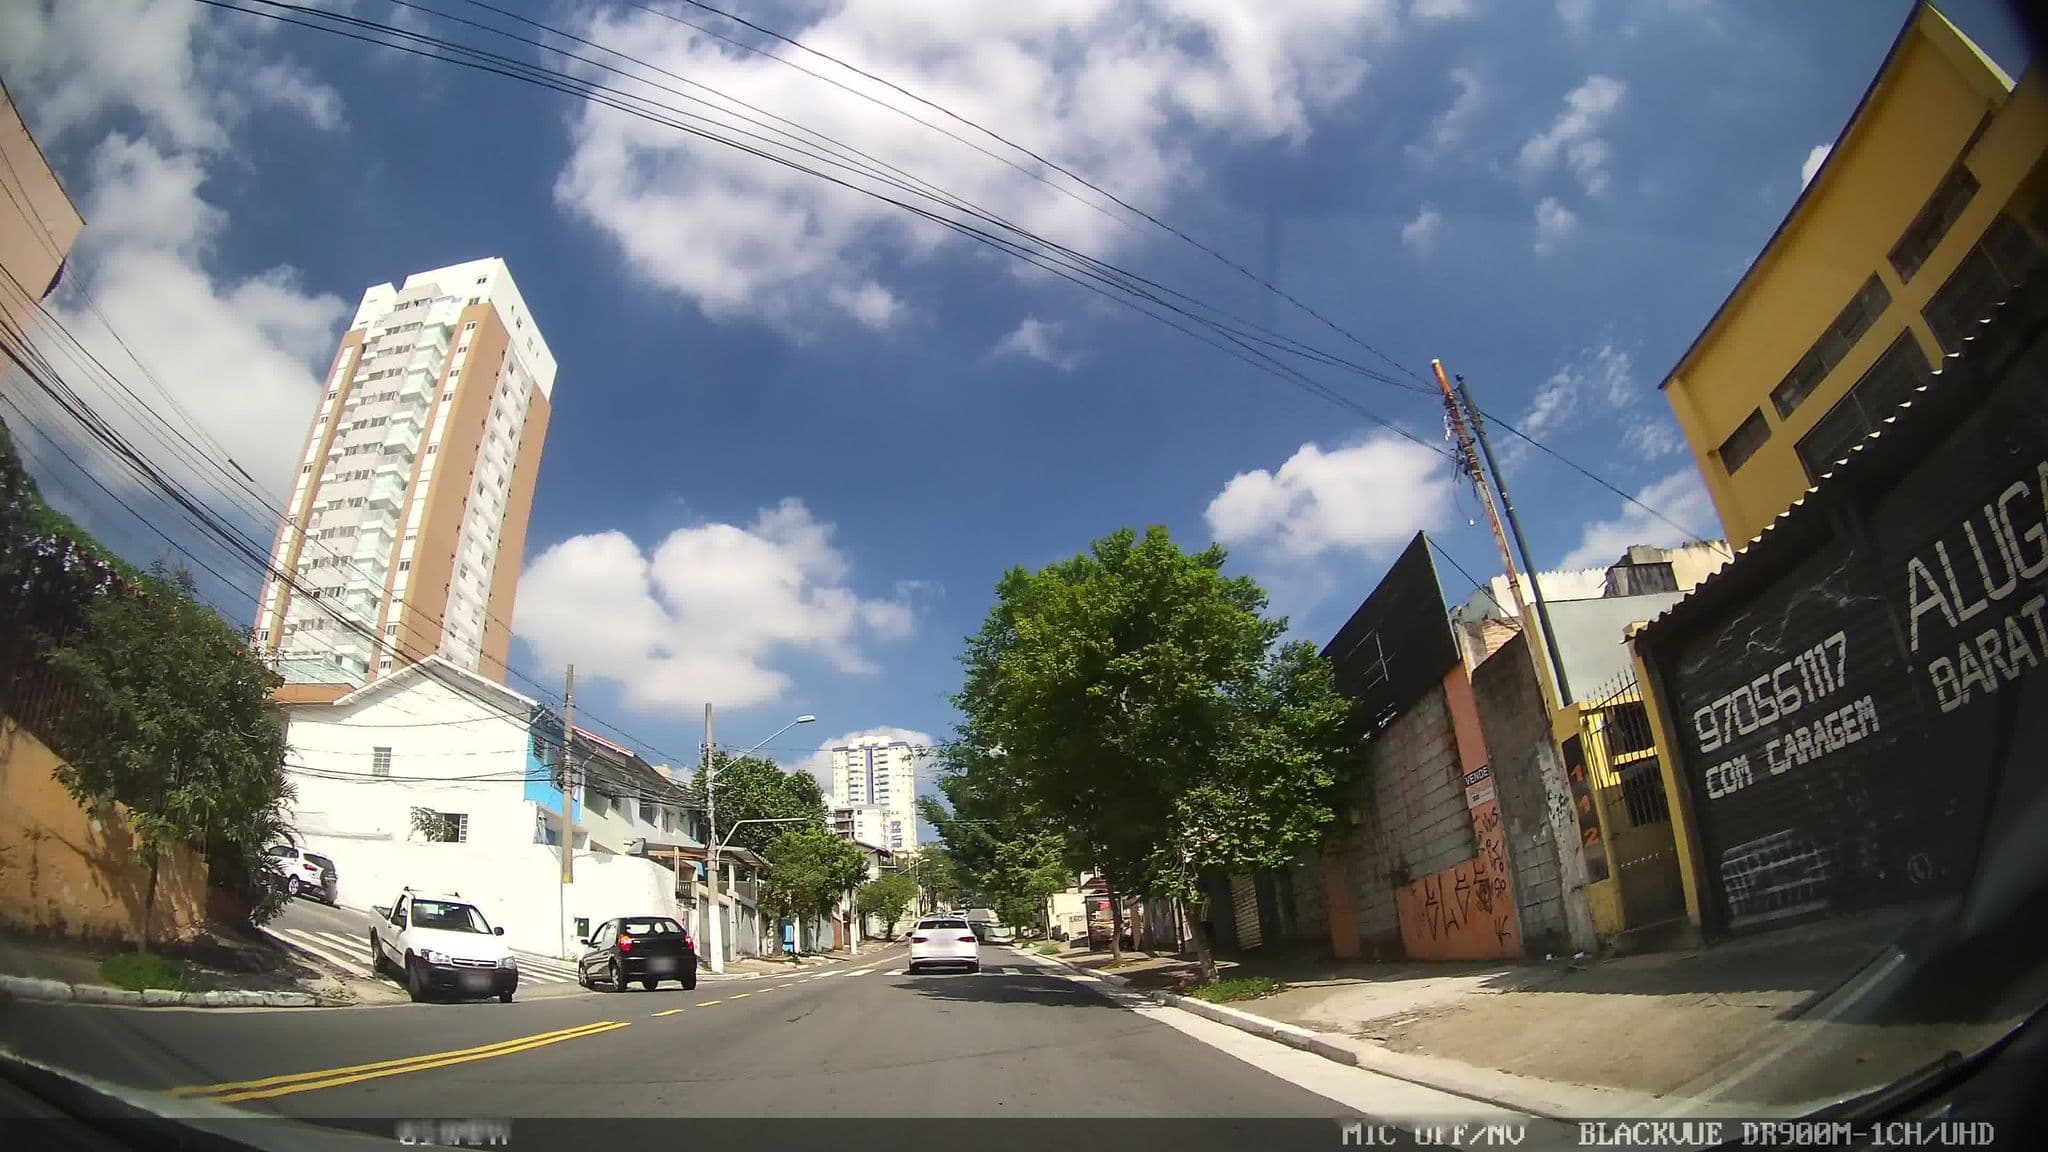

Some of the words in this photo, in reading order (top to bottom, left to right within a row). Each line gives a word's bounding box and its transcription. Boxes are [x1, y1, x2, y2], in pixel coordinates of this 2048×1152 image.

[1693, 630, 1846, 753] 970561117
[1464, 766, 1489, 785] VENDE
[1706, 754, 1753, 799] COM
